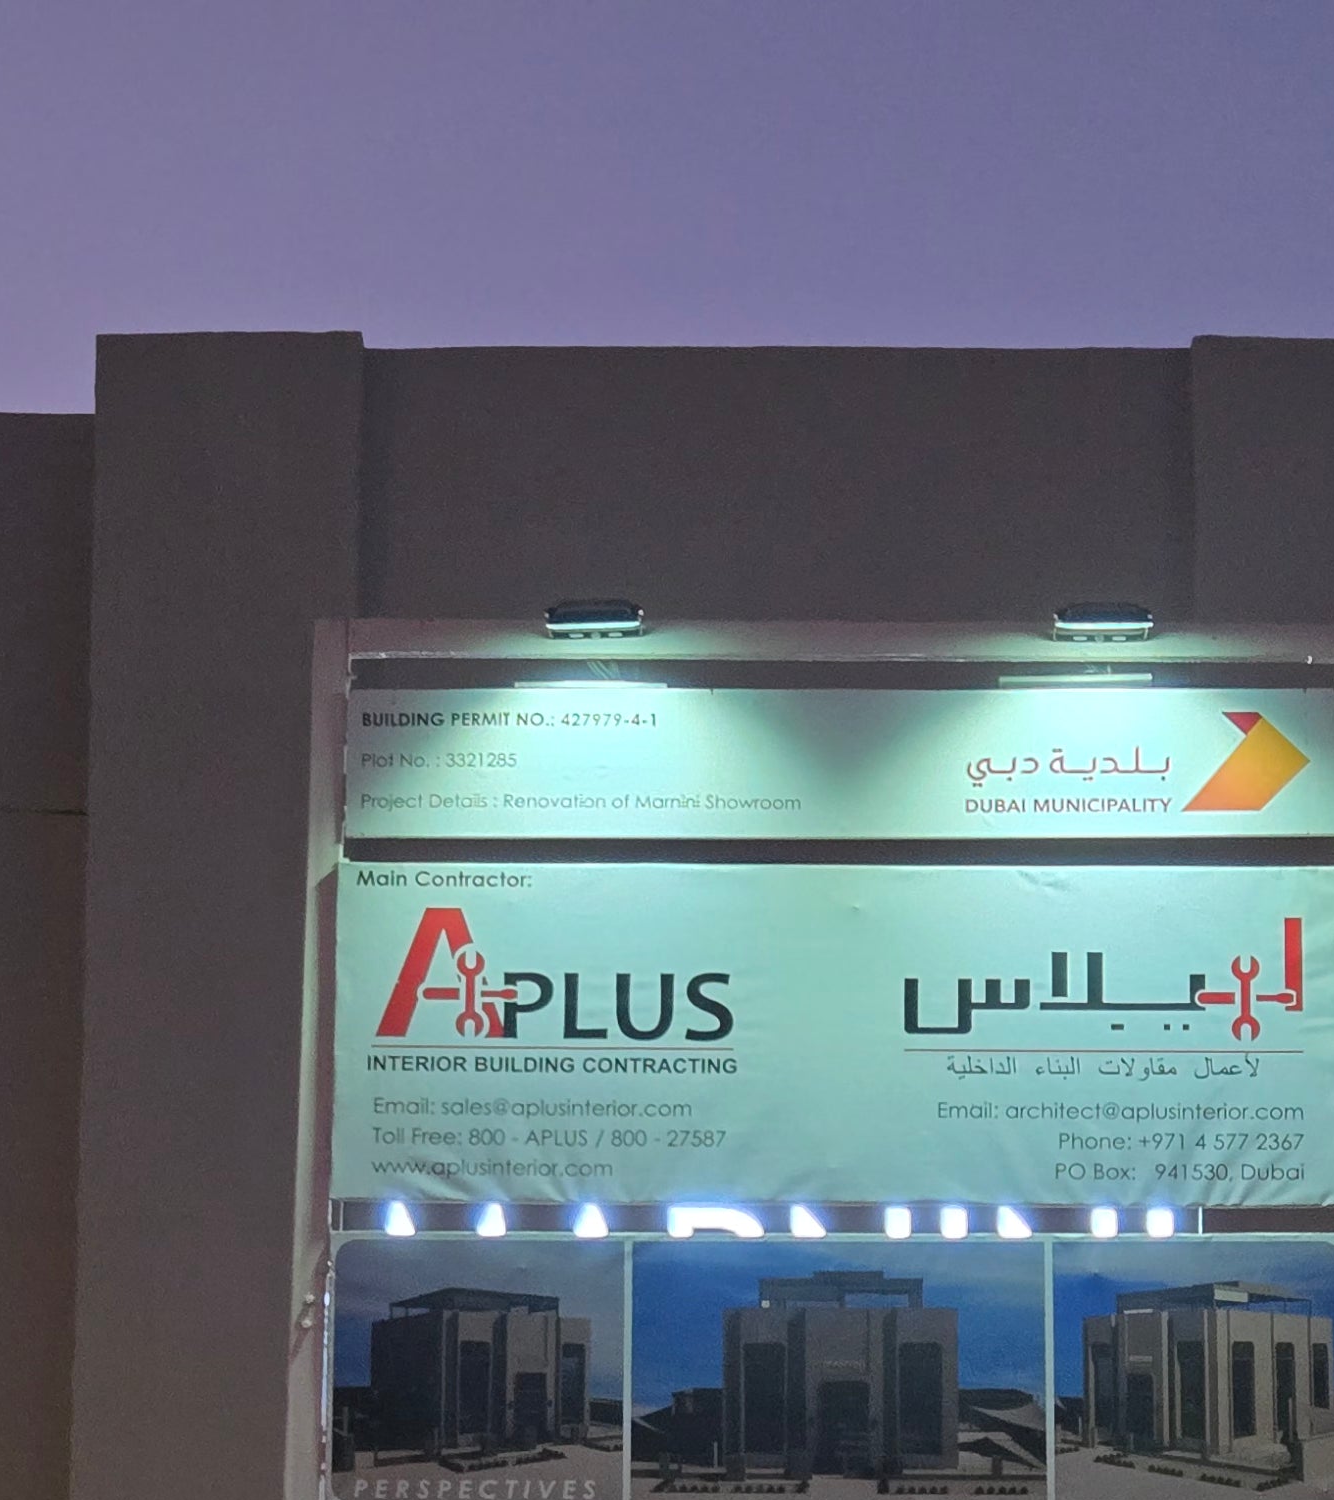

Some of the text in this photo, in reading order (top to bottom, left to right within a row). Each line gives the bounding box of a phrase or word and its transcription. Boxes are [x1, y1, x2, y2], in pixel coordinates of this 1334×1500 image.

[362, 712, 658, 728] BUILDING PERMIT NO.: 427979-4-1
[361, 753, 394, 768] Plot
[445, 753, 518, 768] 3321285
[967, 746, 1171, 787] بلدية دبي
[361, 793, 422, 811] Project
[430, 794, 488, 808] Details
[503, 793, 607, 810] Renovation
[612, 795, 630, 809] of
[705, 795, 801, 810] Showroom
[966, 799, 1172, 813] DUBAI MUNICIPALITY
[356, 870, 532, 888] Main Contractor:
[367, 1055, 737, 1075] INTERIOR BUILDING CONTRACTING
[947, 1055, 1016, 1079] الداخلية
[1036, 1057, 1081, 1080] البناء
[1098, 1057, 1177, 1081] مقاولات
[374, 1098, 692, 1119] Email: sales@aplusinterior.com
[938, 1102, 1304, 1124] Email: architect@aplusinterior.com
[373, 1128, 404, 1146] Toll
[411, 1129, 461, 1146] Free:
[469, 1129, 504, 1146] 800
[525, 1130, 587, 1147] APLUS
[611, 1131, 647, 1147] 800
[667, 1130, 726, 1148] 27587
[1059, 1133, 1304, 1151] Phone: +971 4 577 2367
[372, 1158, 612, 1178] www.aplusinterior.com
[1055, 1164, 1086, 1181] PO
[1093, 1164, 1136, 1181] Box:
[1241, 1164, 1305, 1181] Dubai
[354, 1479, 597, 1500] PERSPECTIVES
